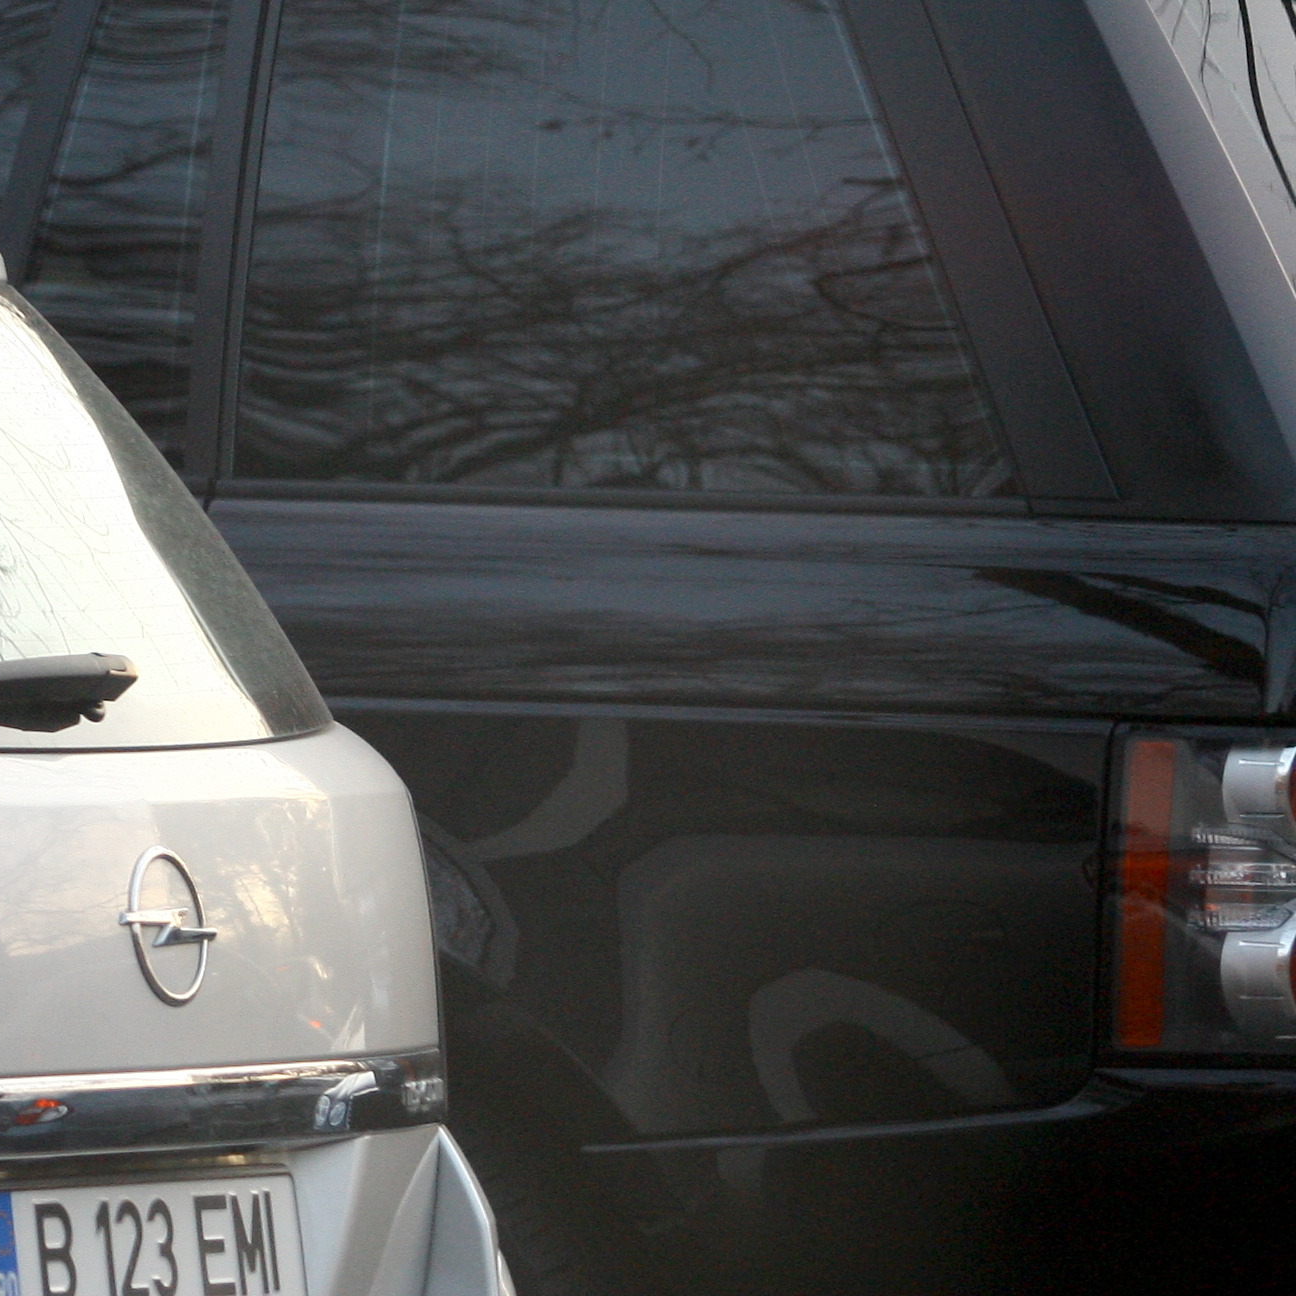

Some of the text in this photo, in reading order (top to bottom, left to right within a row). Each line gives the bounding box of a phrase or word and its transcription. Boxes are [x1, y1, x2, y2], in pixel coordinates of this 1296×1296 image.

[34, 1189, 280, 1296] B 123 EMI
